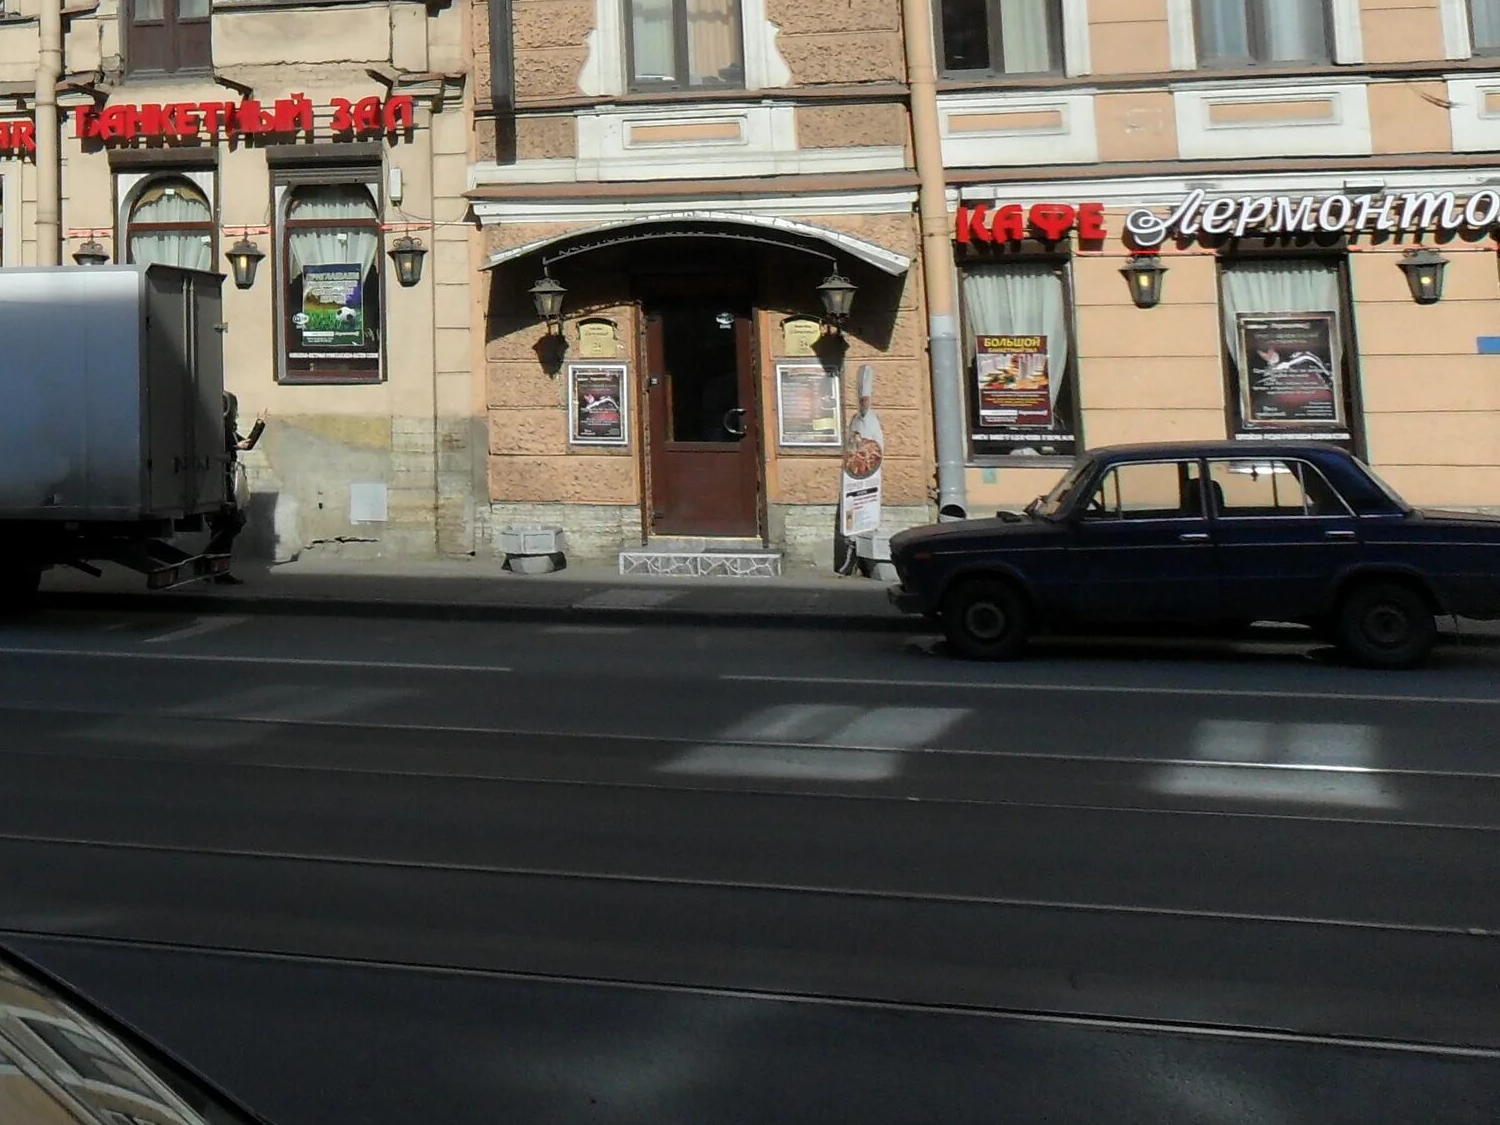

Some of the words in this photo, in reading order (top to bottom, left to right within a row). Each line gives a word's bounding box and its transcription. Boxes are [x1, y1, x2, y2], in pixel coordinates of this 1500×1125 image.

[75, 92, 312, 140] БАНКЕТНЫЙ
[329, 95, 414, 132] ЗАЛ
[956, 202, 1107, 244] КАФЕ
[1126, 188, 1500, 246] Лермонто
[983, 336, 1041, 348] БОЛЬШОЙ
